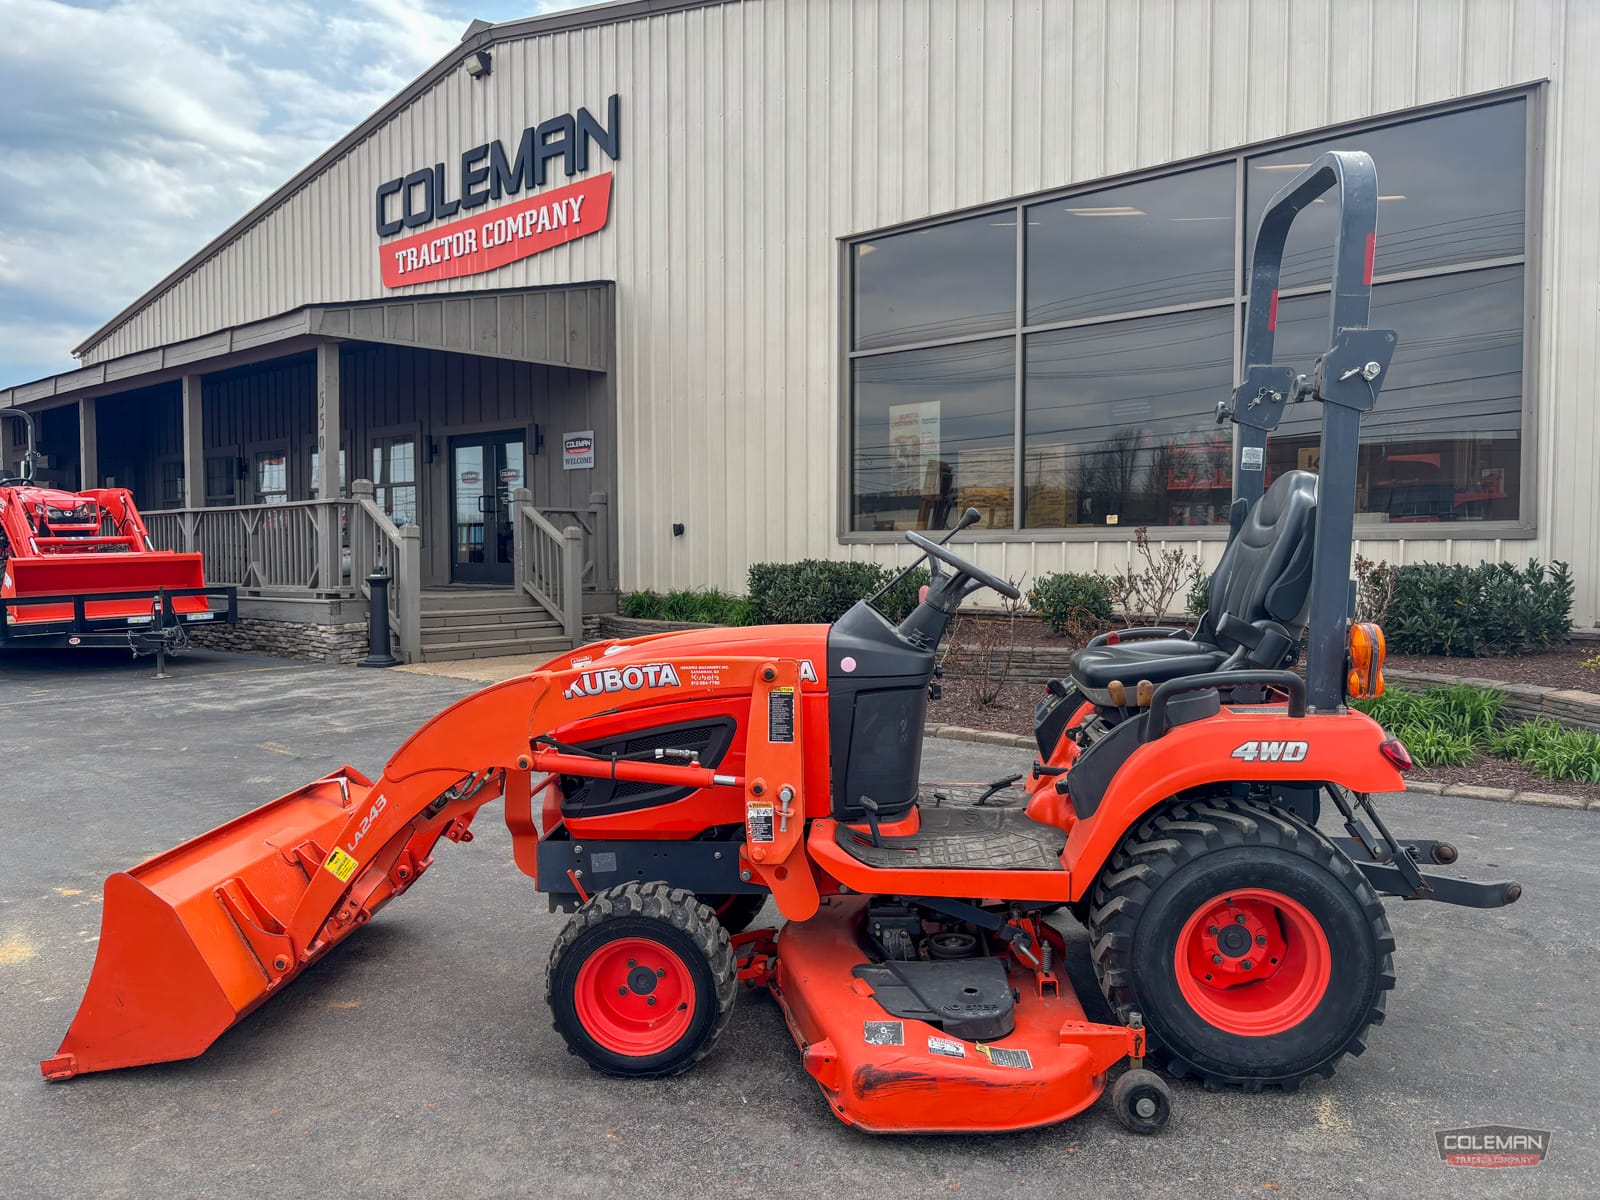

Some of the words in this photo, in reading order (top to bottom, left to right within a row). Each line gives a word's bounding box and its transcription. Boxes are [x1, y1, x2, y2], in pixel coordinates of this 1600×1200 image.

[375, 93, 620, 238] COLEMAN
[394, 228, 478, 275] TRACTOR
[481, 194, 586, 250] COMPANY
[565, 457, 592, 465] WELCOME
[566, 439, 591, 449] COLEMAN
[563, 663, 682, 700] KUBOTA
[1231, 740, 1309, 762] 4WD
[348, 794, 387, 851] LA243
